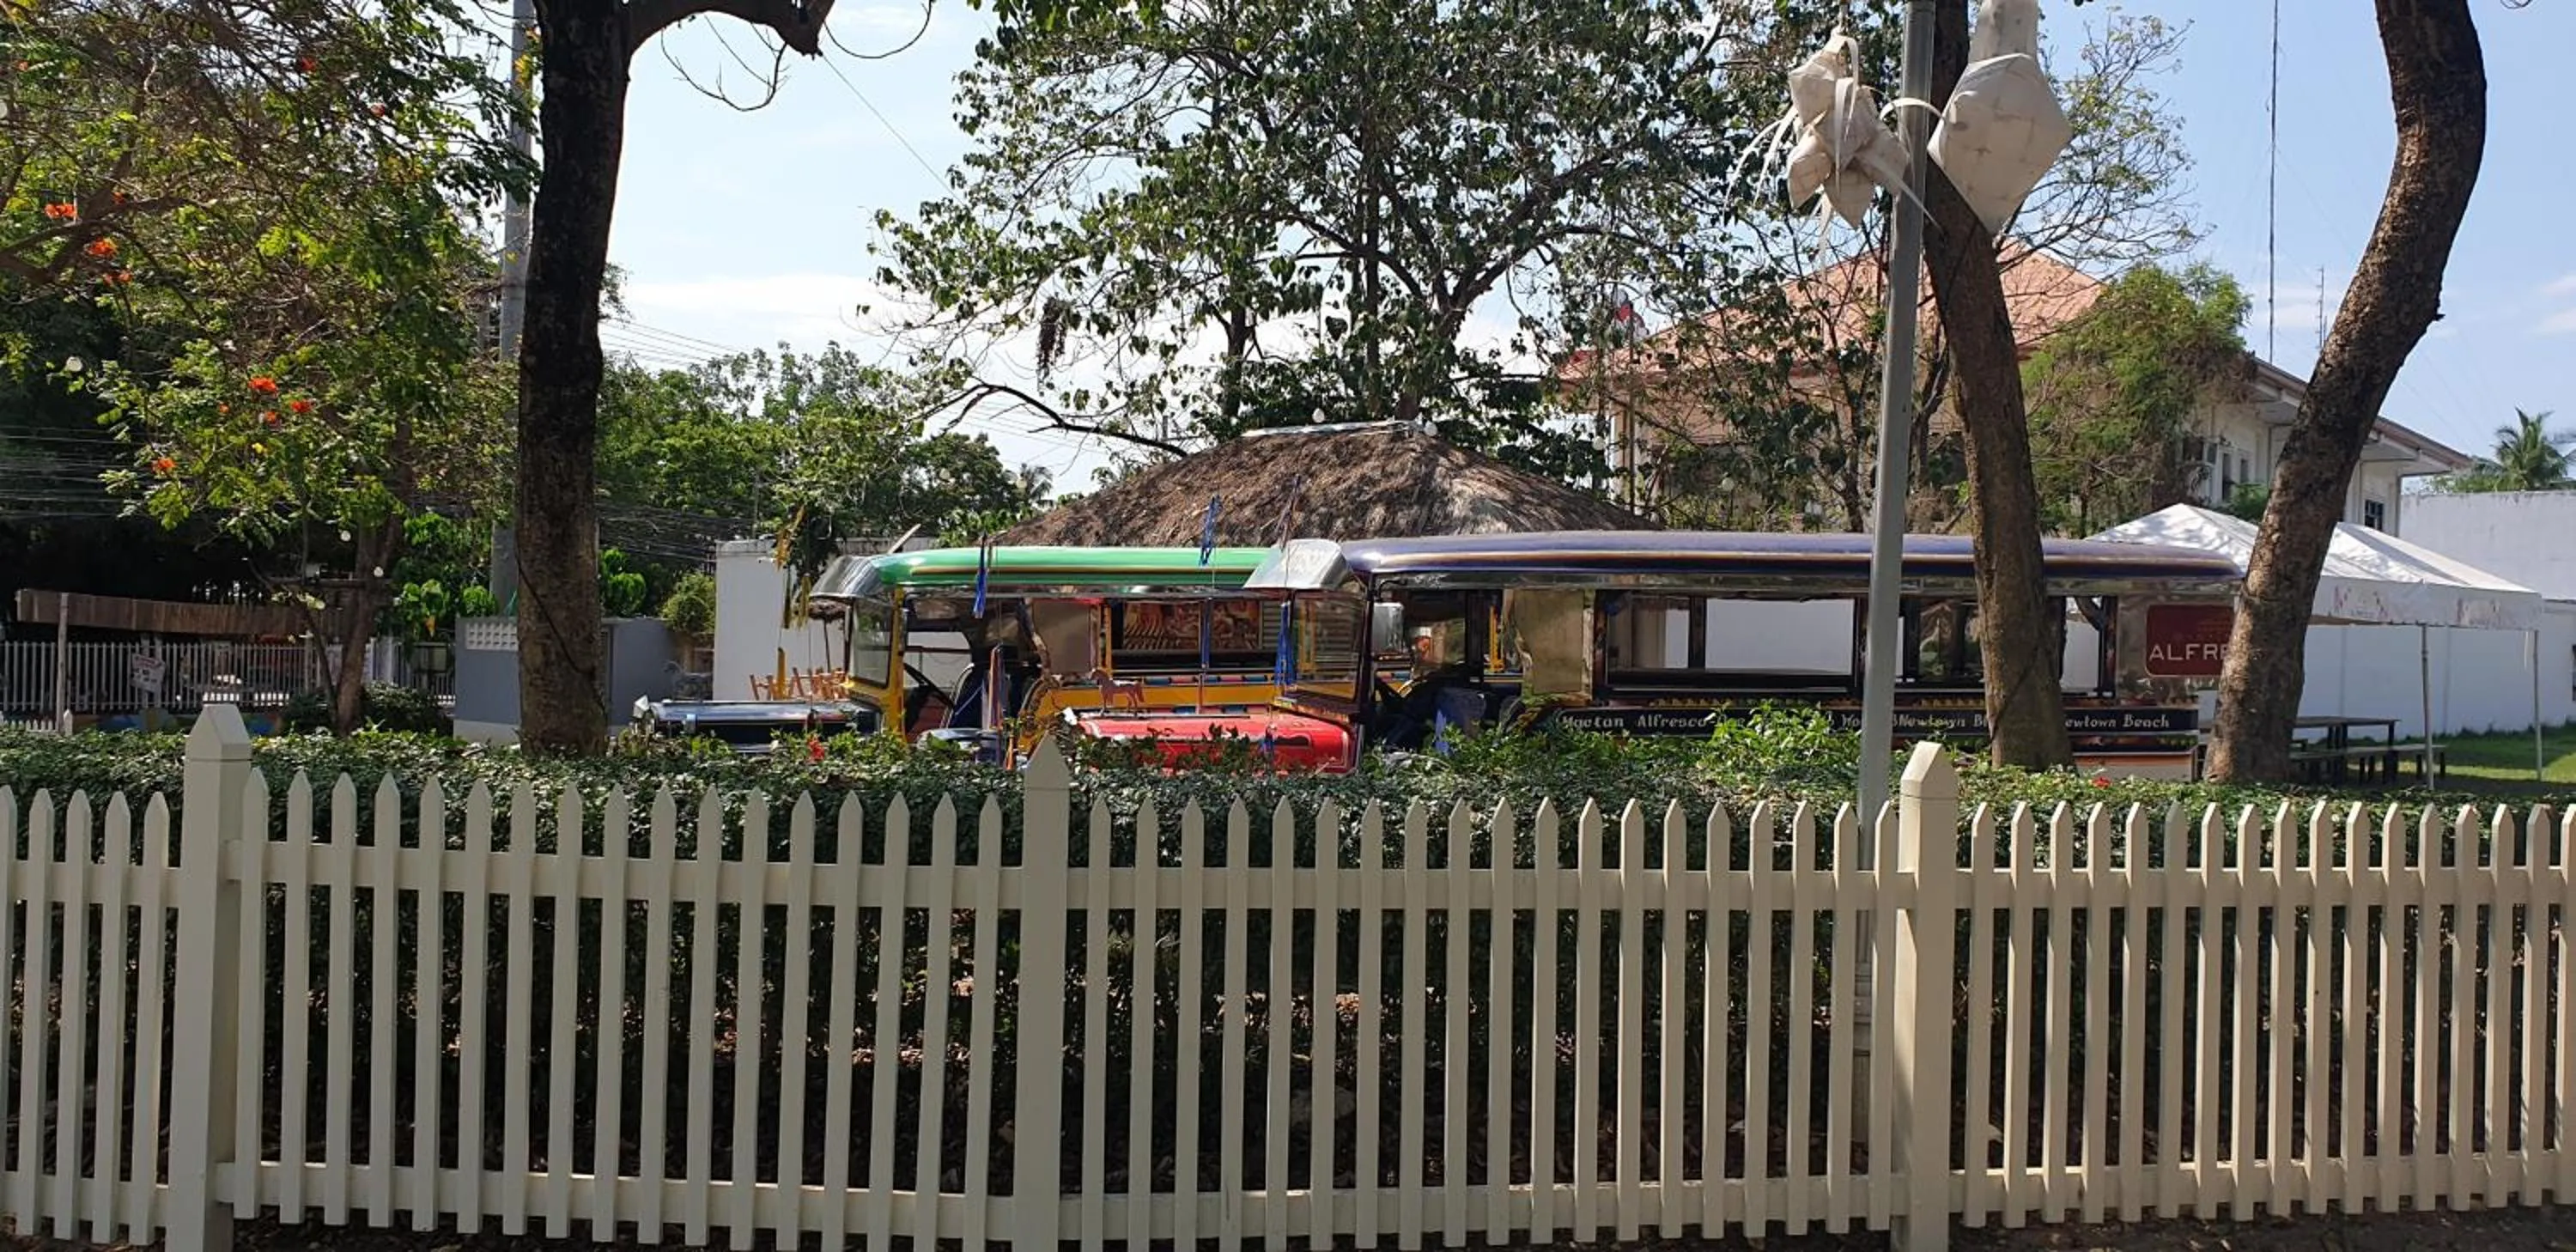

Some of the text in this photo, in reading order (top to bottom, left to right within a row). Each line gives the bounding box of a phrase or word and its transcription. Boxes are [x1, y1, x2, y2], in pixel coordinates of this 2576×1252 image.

[2149, 642, 2229, 660] ALFRE
[2064, 714, 2117, 728] ewtown
[2123, 714, 2170, 728] Beach
